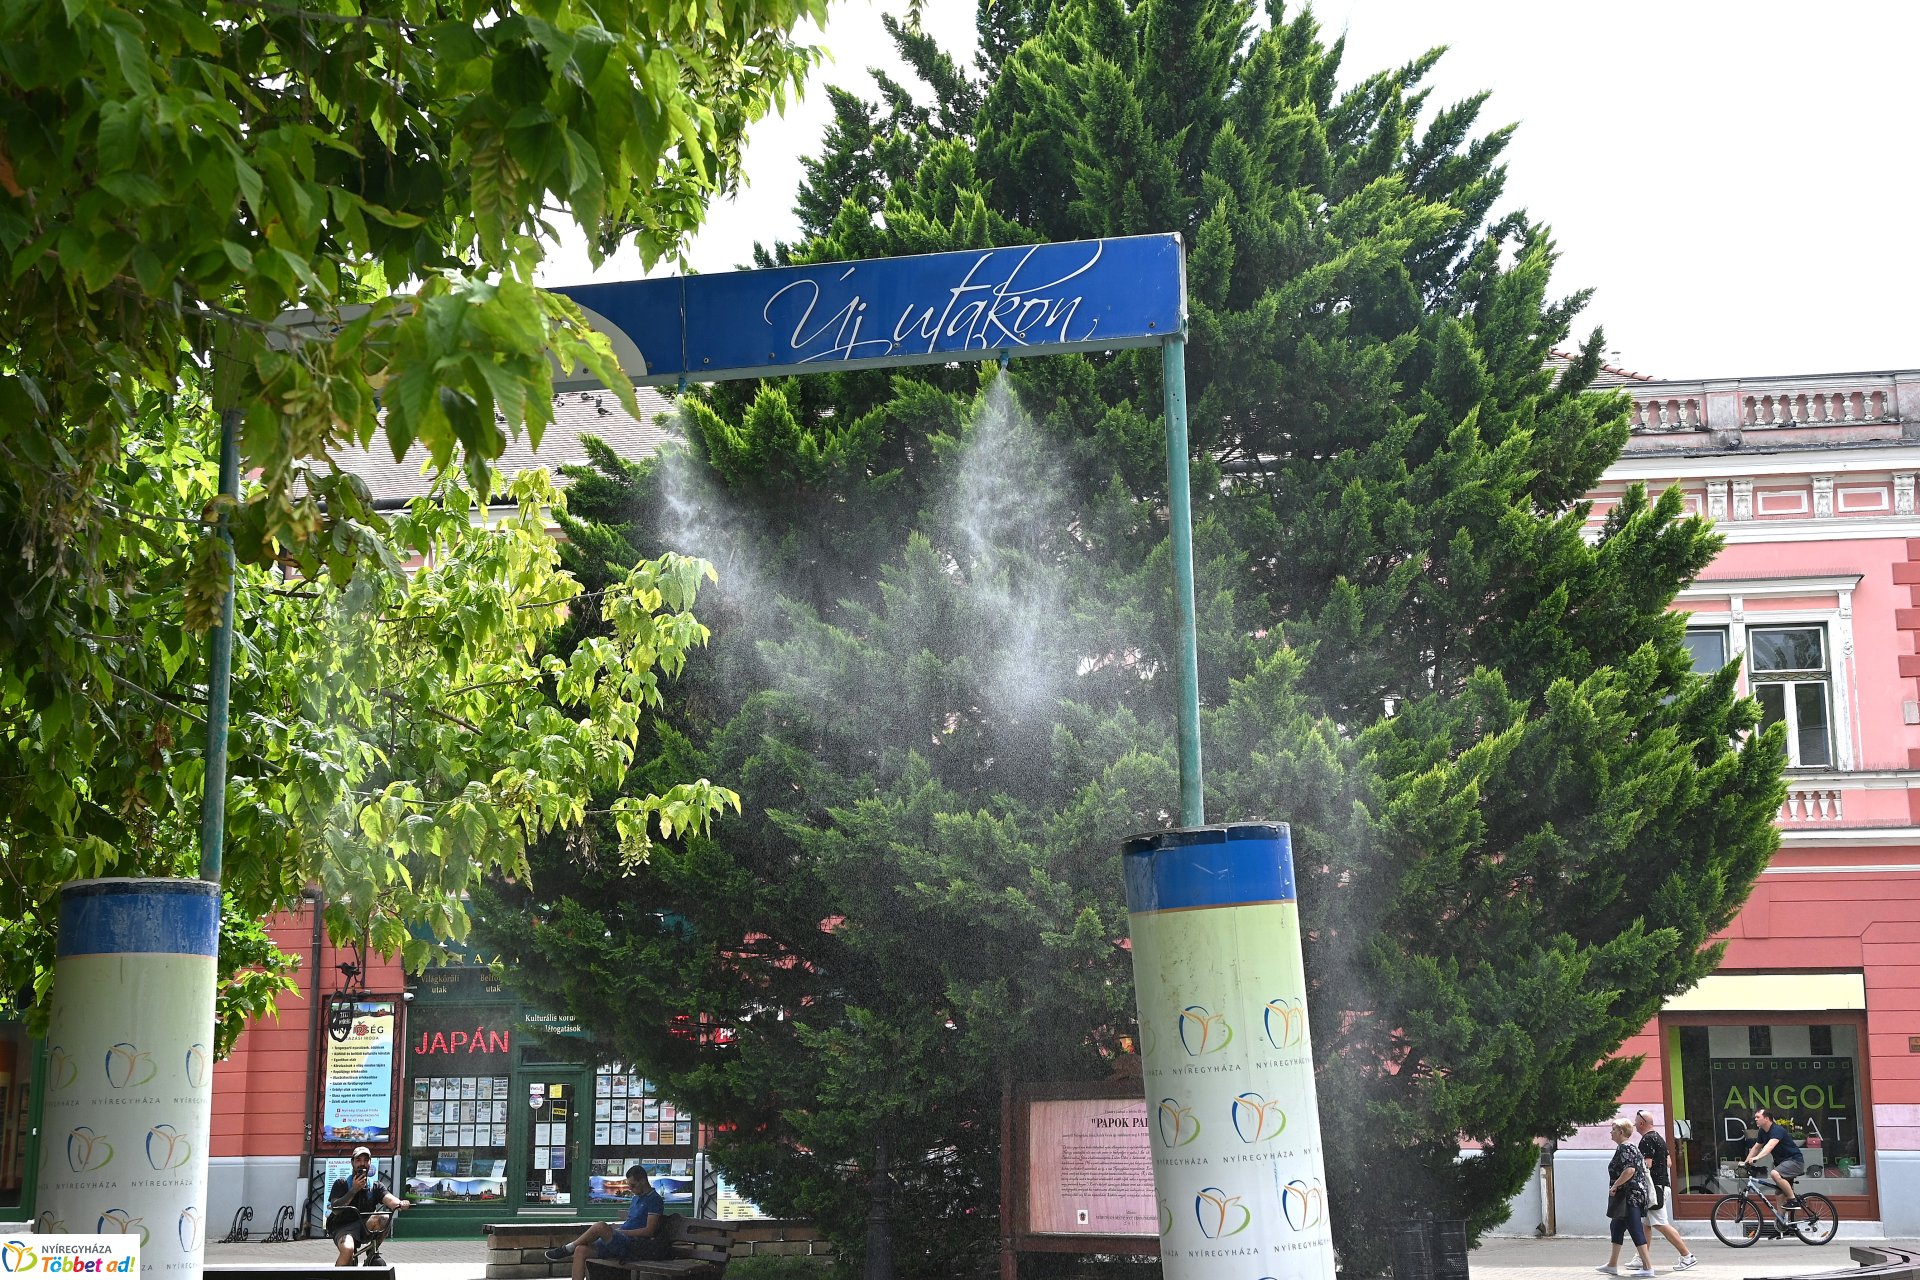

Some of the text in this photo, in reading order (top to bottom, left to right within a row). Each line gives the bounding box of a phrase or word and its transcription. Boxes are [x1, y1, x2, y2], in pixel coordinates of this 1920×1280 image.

[893, 239, 1103, 354] utakon
[486, 985, 501, 993] utak
[525, 1014, 557, 1022] Kulturális
[415, 1026, 509, 1055] JAPÁN
[1173, 1064, 1241, 1075] NYÍREGYHÁZA
[91, 1096, 161, 1105] NYÍREGYHÁZA
[1724, 1085, 1846, 1109] ANGOL
[1725, 1117, 1847, 1142] DAT
[1223, 1151, 1294, 1163] NYÍREGYHÁZA
[56, 1181, 117, 1189] NYÍREGYHÁZA
[131, 1179, 193, 1188] NYÍREGYHÁZA
[1189, 1246, 1259, 1258] NYÍREGYHÁZA
